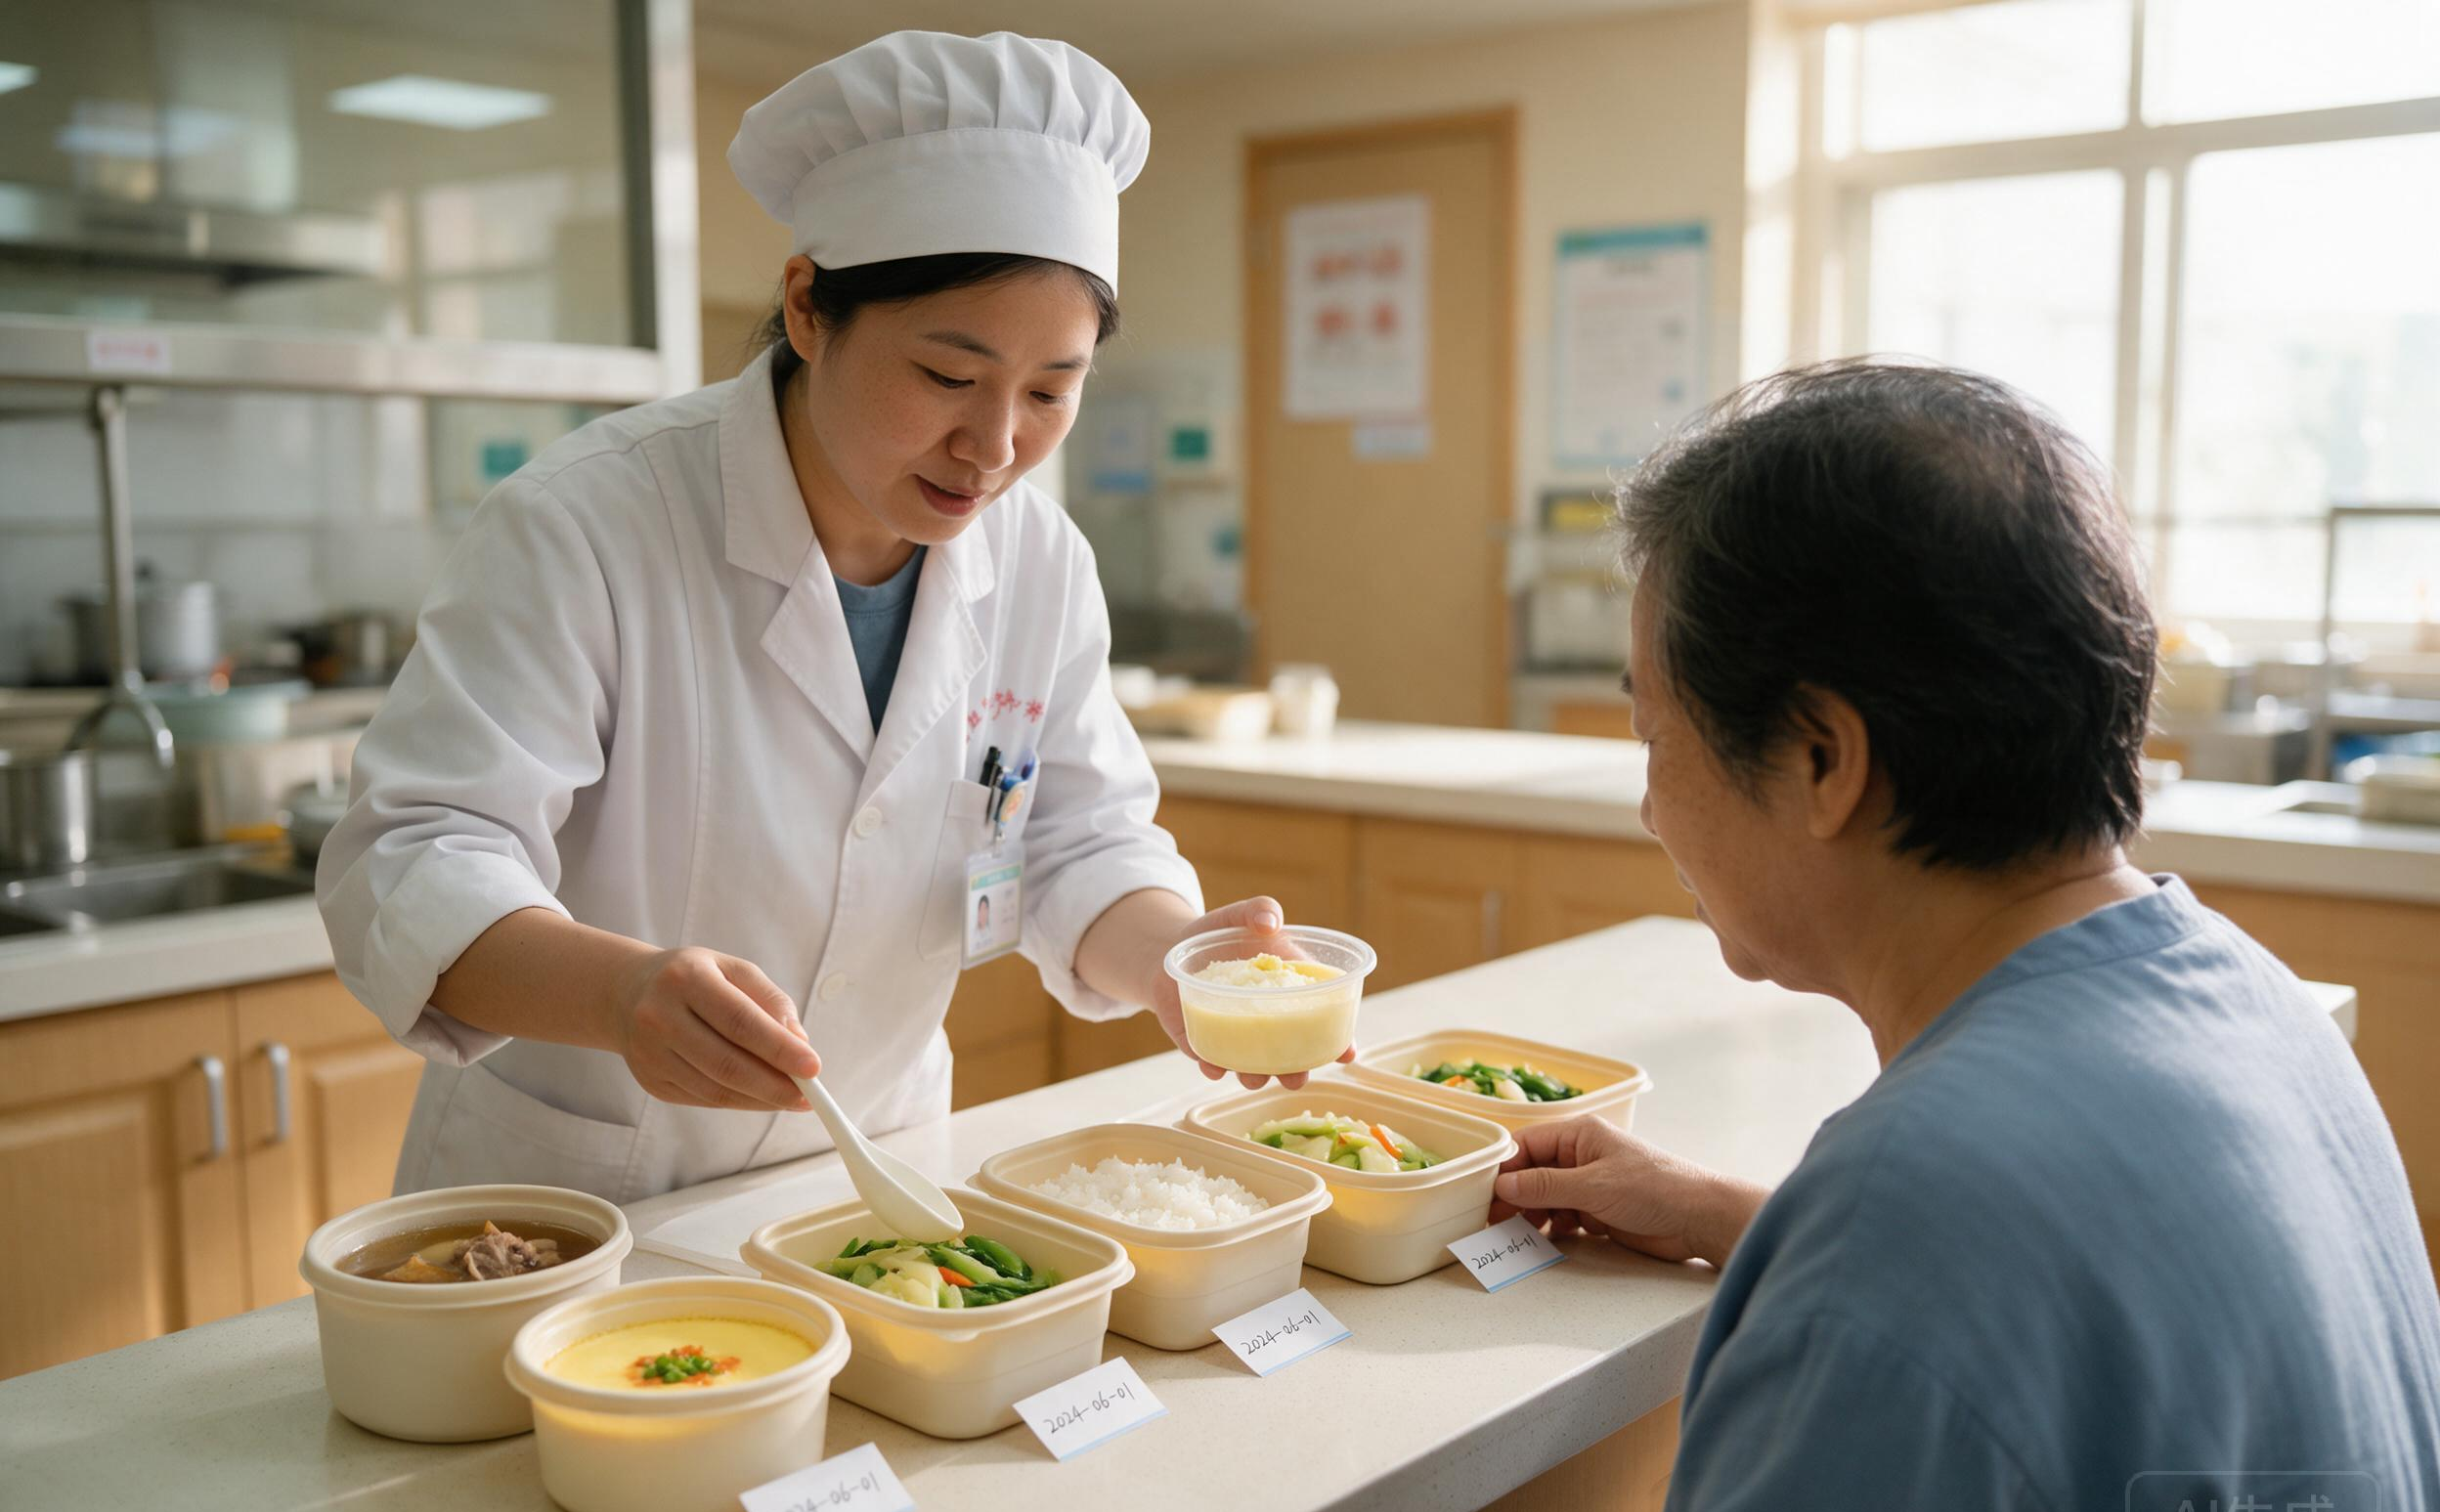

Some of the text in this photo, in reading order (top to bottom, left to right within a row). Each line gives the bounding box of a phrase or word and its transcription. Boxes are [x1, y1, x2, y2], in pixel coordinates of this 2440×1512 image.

[1241, 1310, 1321, 1355] 2024-06-01
[1043, 1382, 1135, 1434] 2024-06-01
[785, 1471, 880, 1512] 24-06-01
